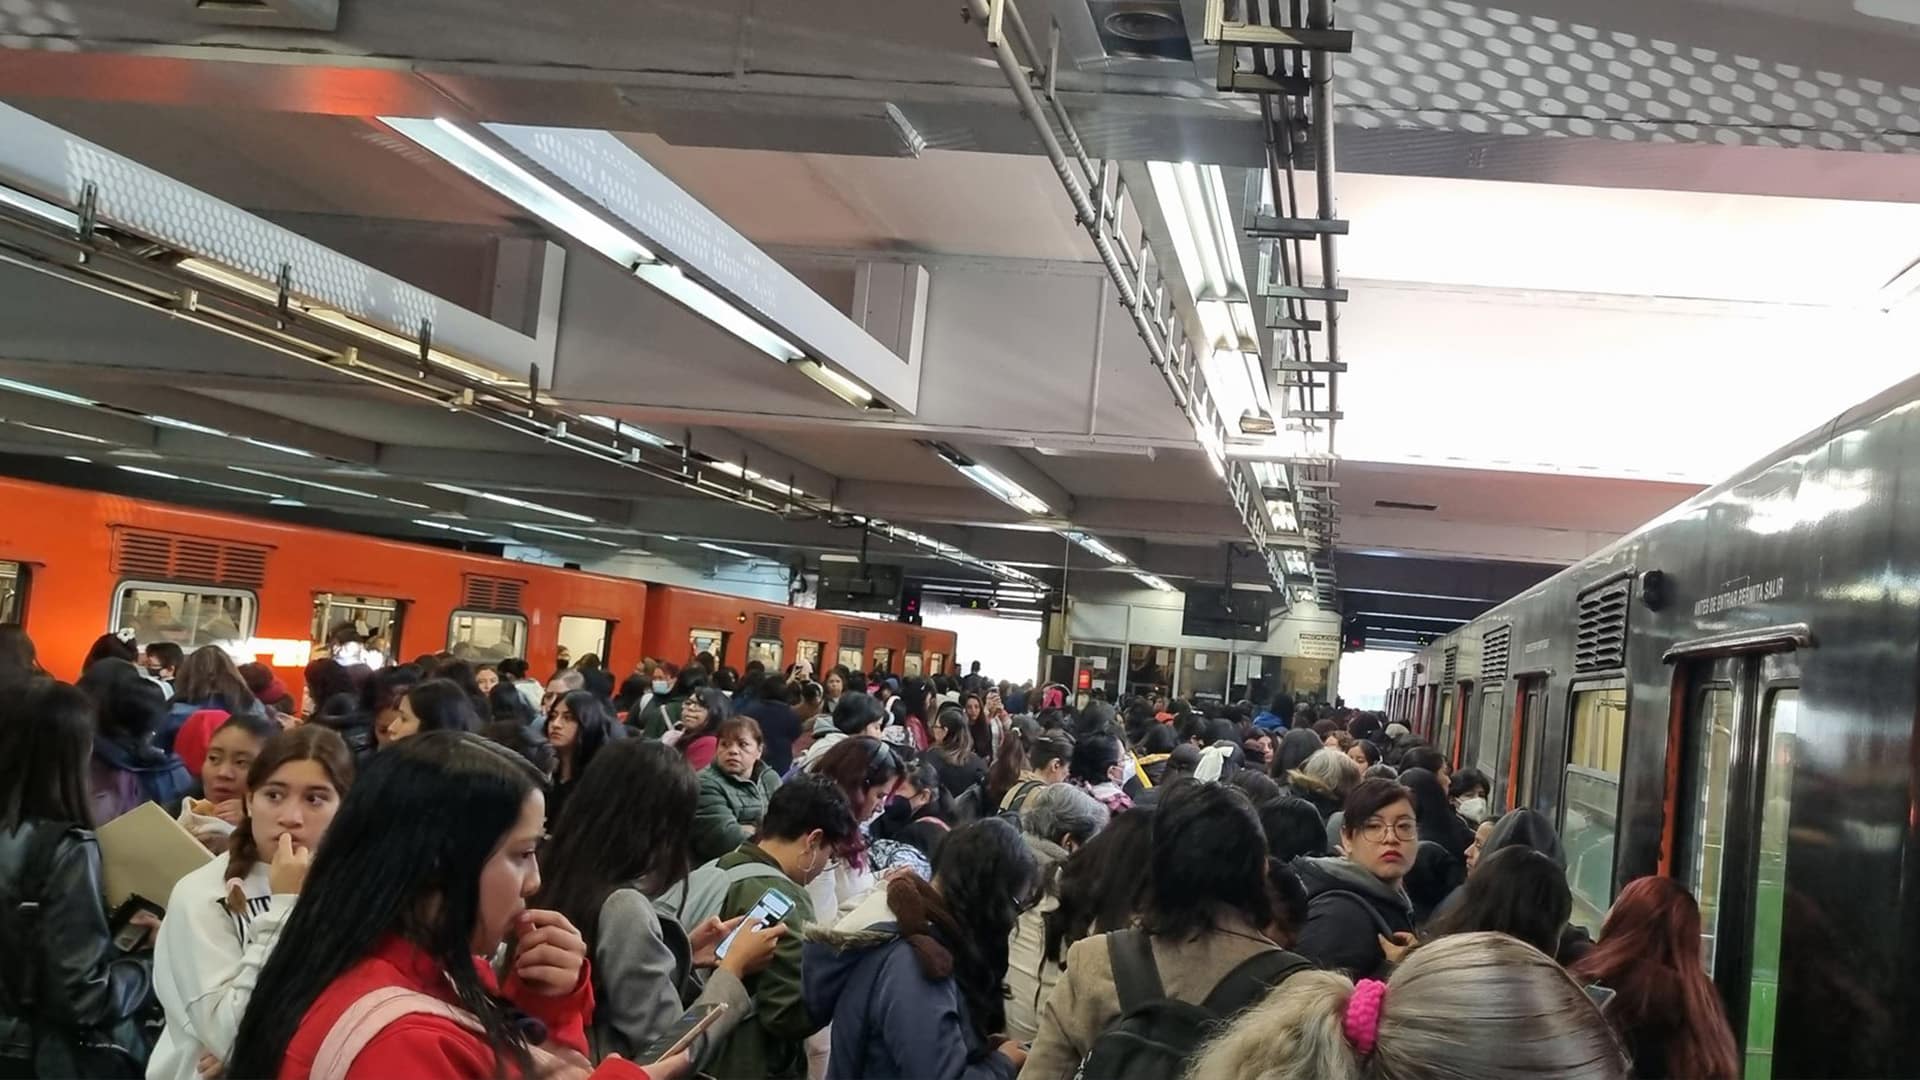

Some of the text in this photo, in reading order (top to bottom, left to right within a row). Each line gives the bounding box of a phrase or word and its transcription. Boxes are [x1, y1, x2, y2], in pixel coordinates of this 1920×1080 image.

[1694, 598, 1709, 617] ANTES
[1717, 590, 1738, 612] ENTRAR
[1738, 583, 1764, 606] PERMITA
[1764, 576, 1784, 601] SALIR
